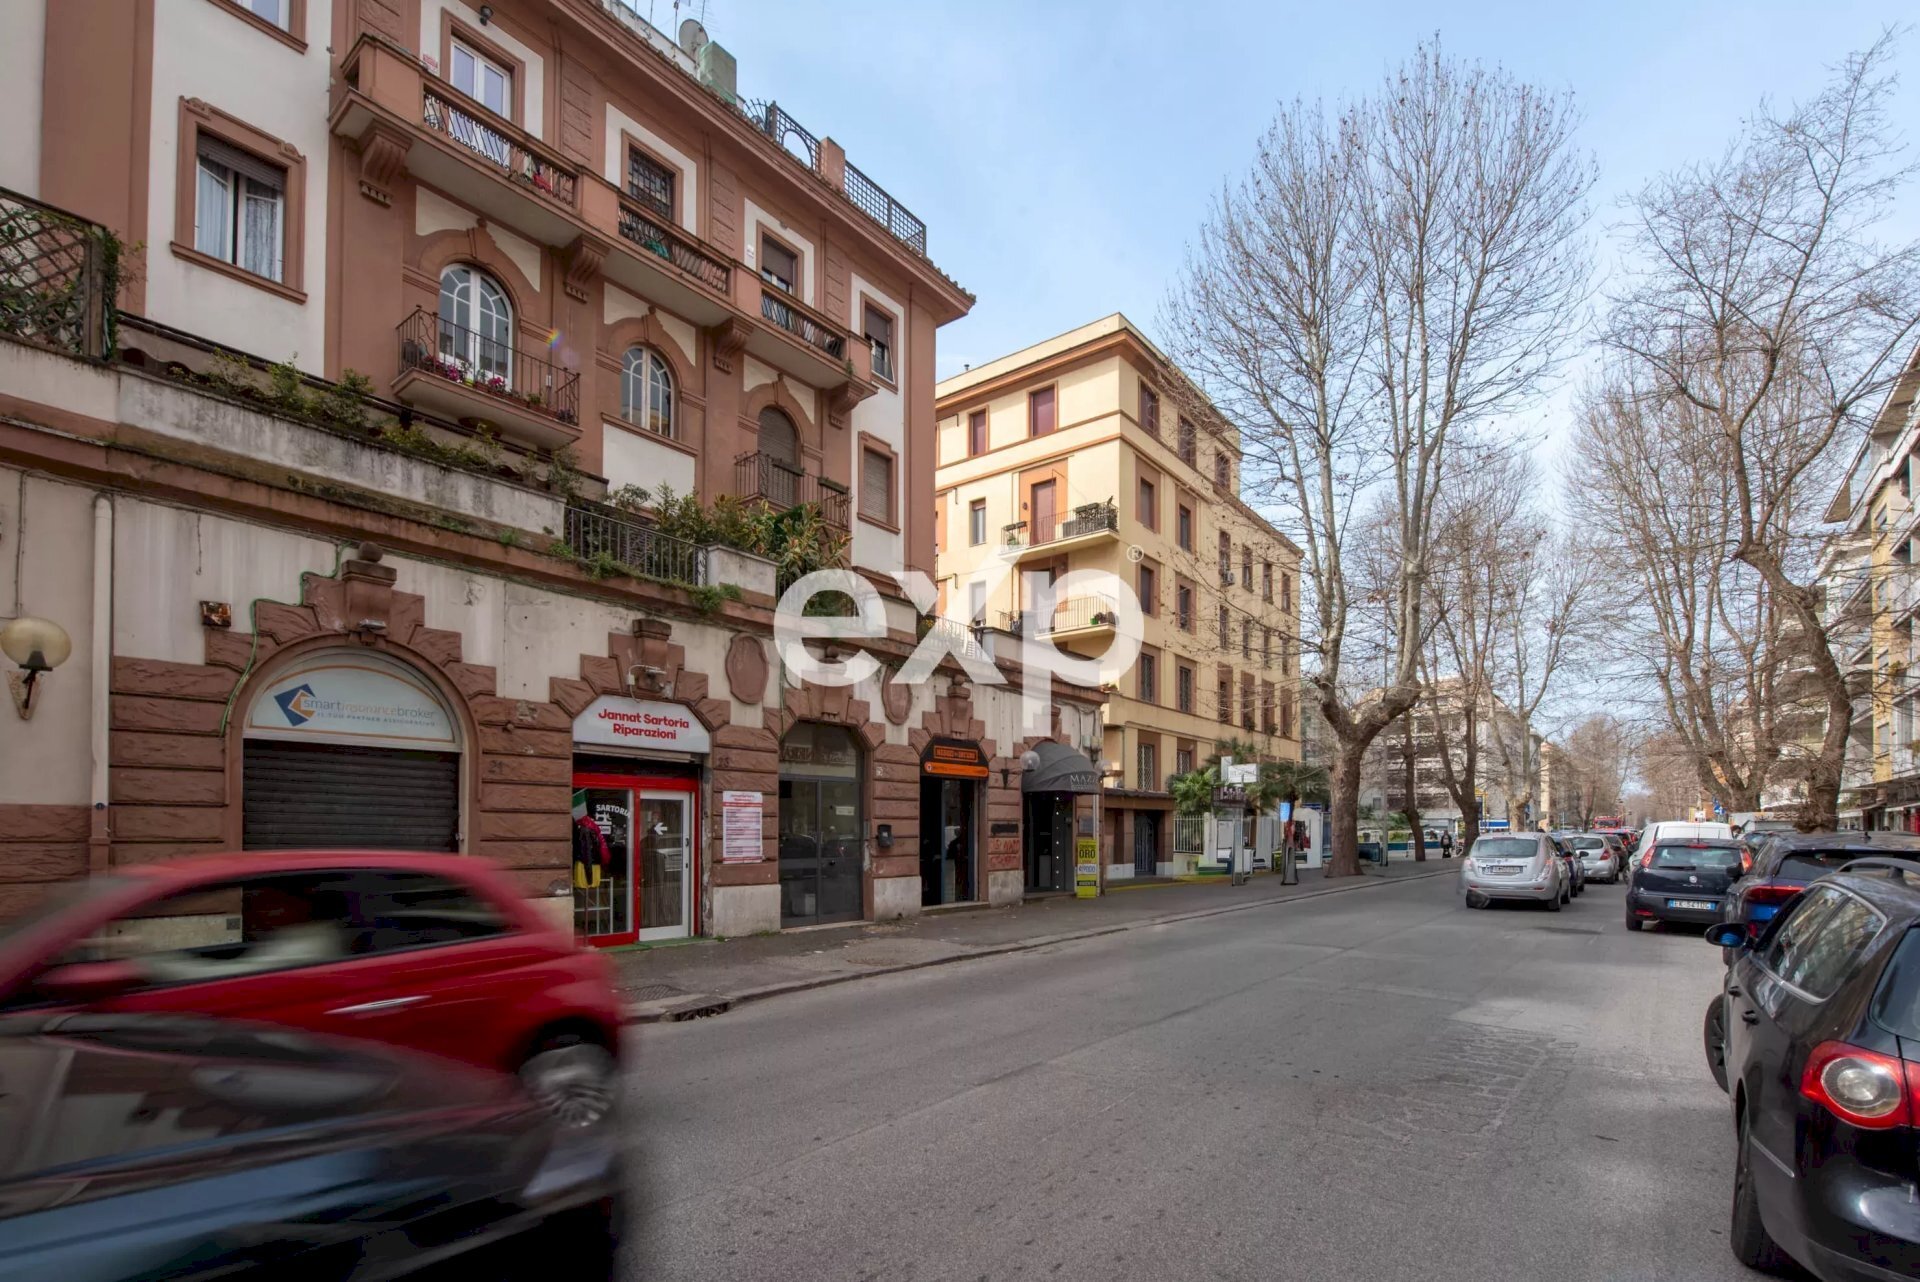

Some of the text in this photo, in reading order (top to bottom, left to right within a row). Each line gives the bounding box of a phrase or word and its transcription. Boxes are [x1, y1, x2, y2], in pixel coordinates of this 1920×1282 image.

[598, 708, 690, 729] Jannat Sartoria
[613, 723, 677, 740] Riparazioni
[1079, 849, 1096, 859] ORO
